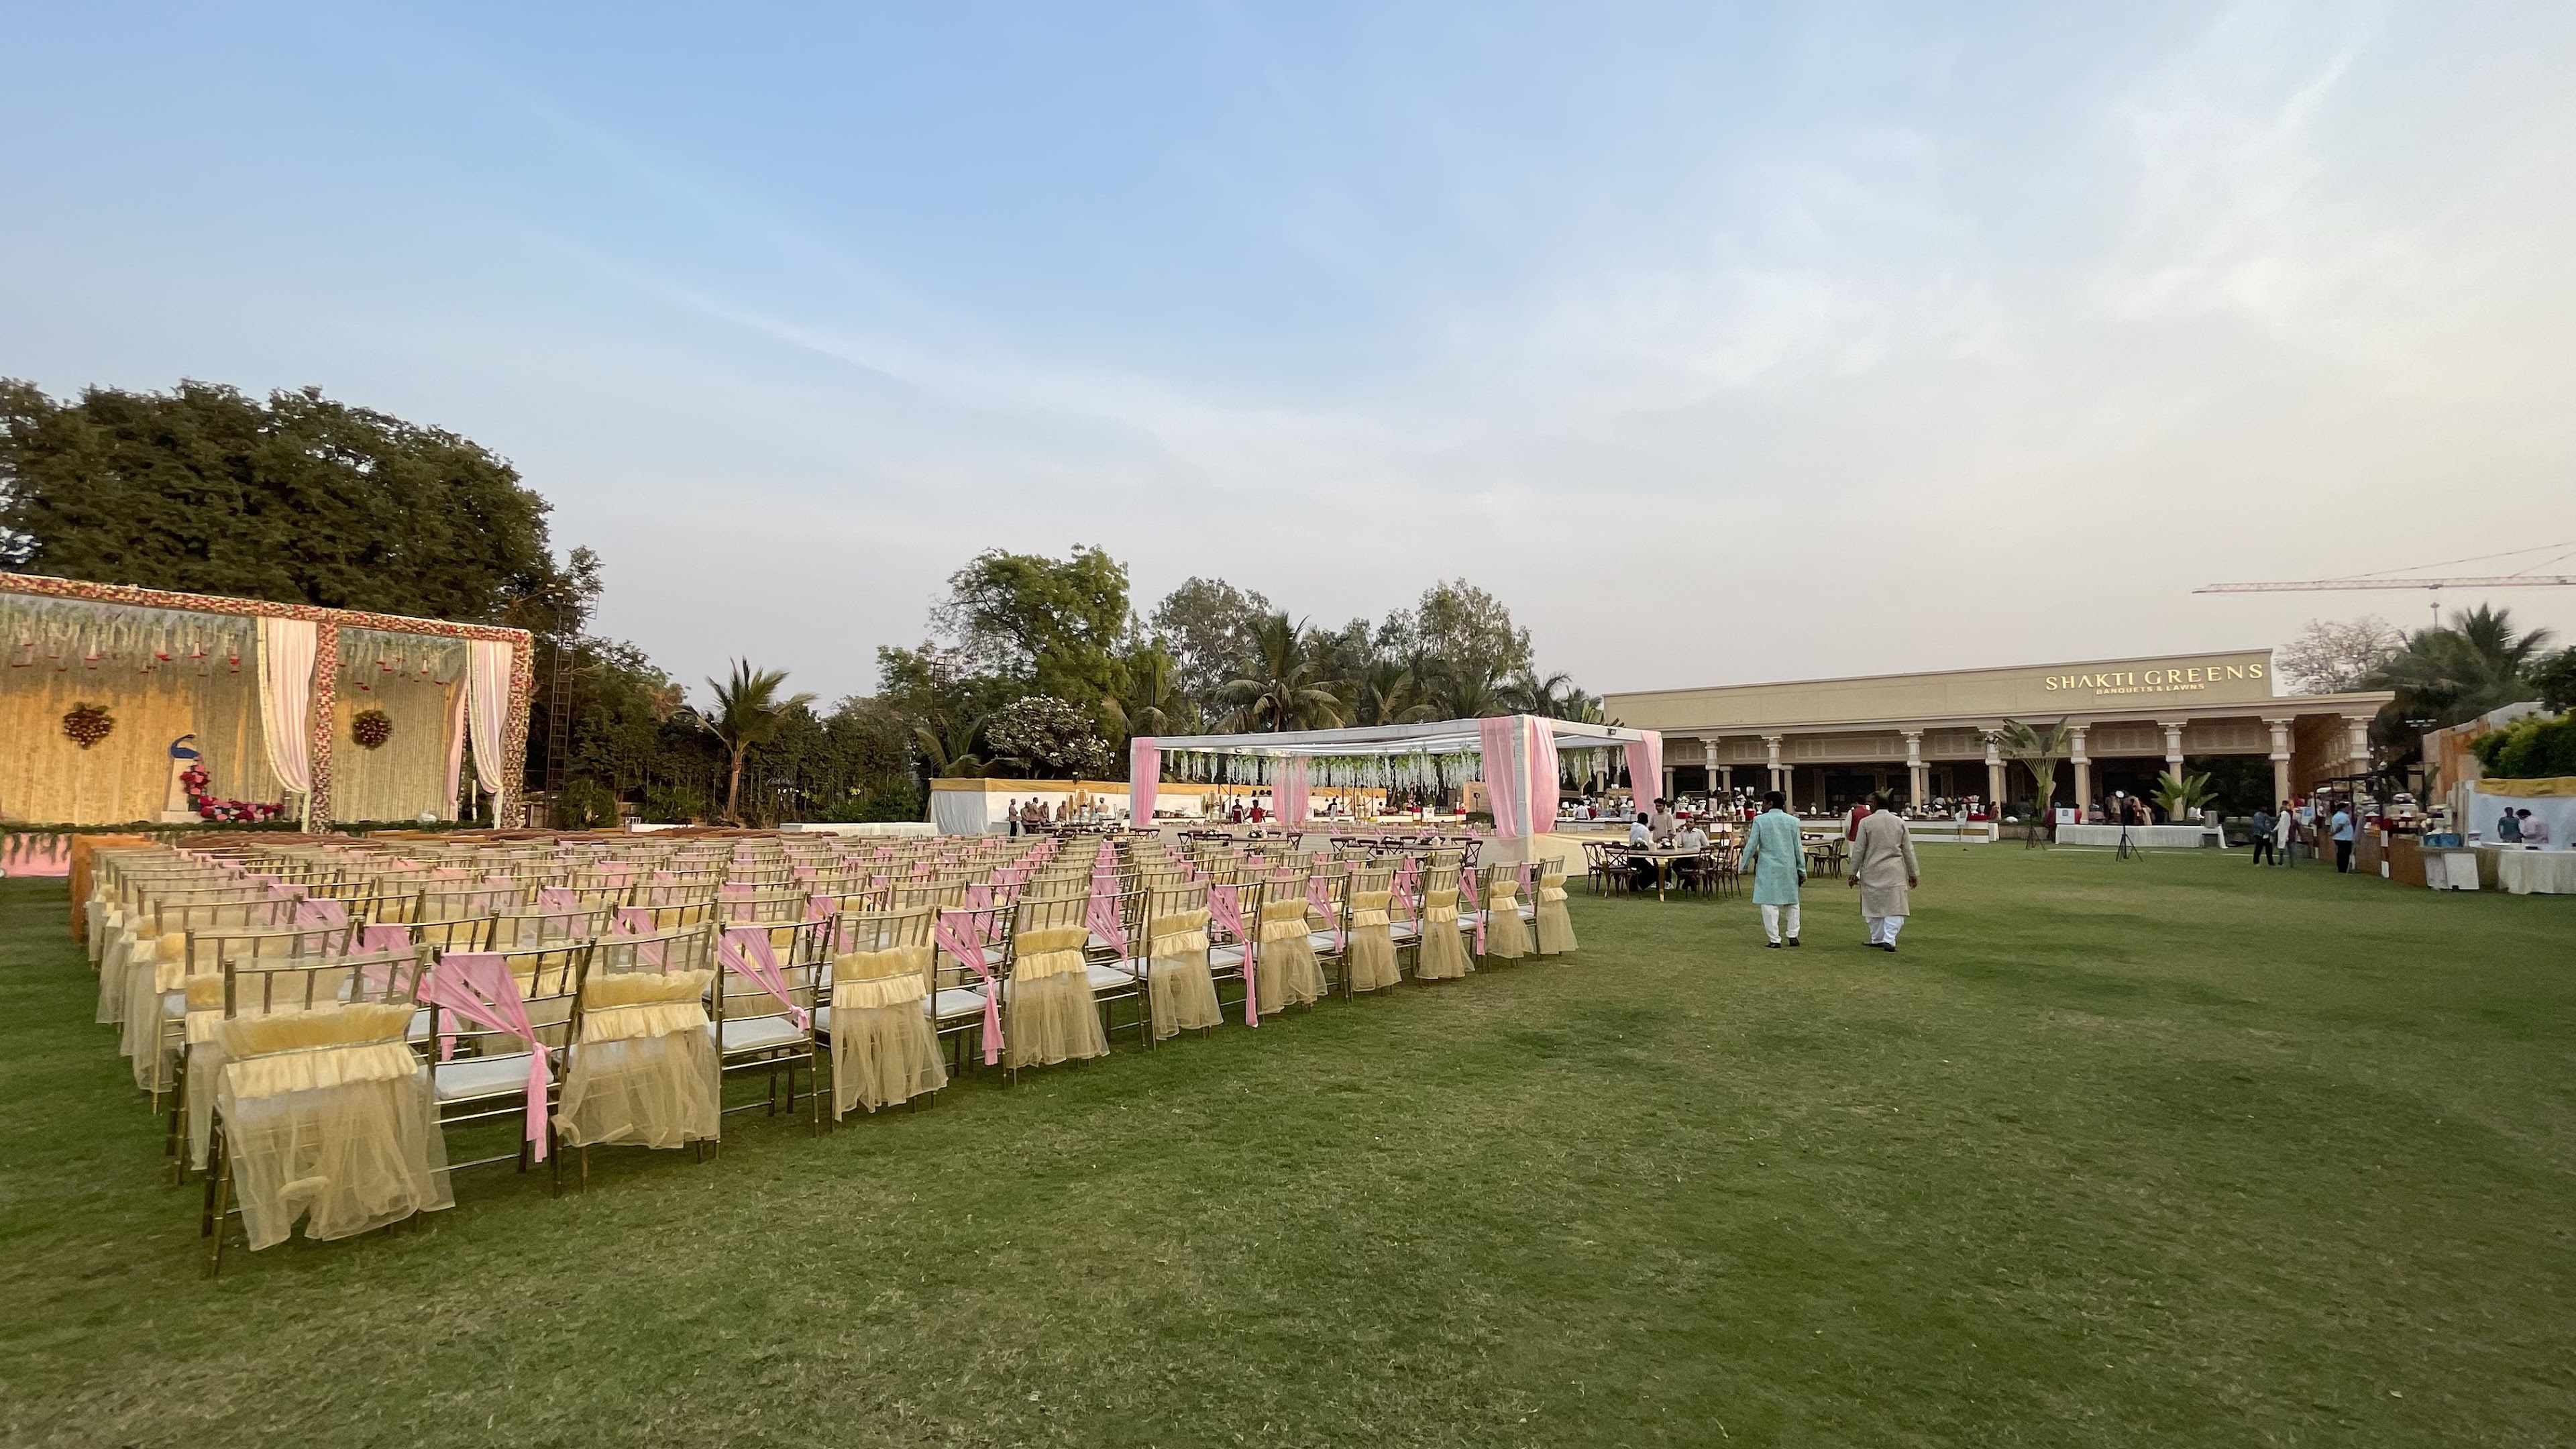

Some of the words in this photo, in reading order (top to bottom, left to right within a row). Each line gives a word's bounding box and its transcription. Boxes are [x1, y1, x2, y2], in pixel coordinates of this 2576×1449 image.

[2045, 672, 2135, 691] SHAKTI
[2144, 663, 2263, 685] GREENS
[2096, 686, 2153, 695] BANQUETS
[2165, 683, 2205, 692] LAWNS
